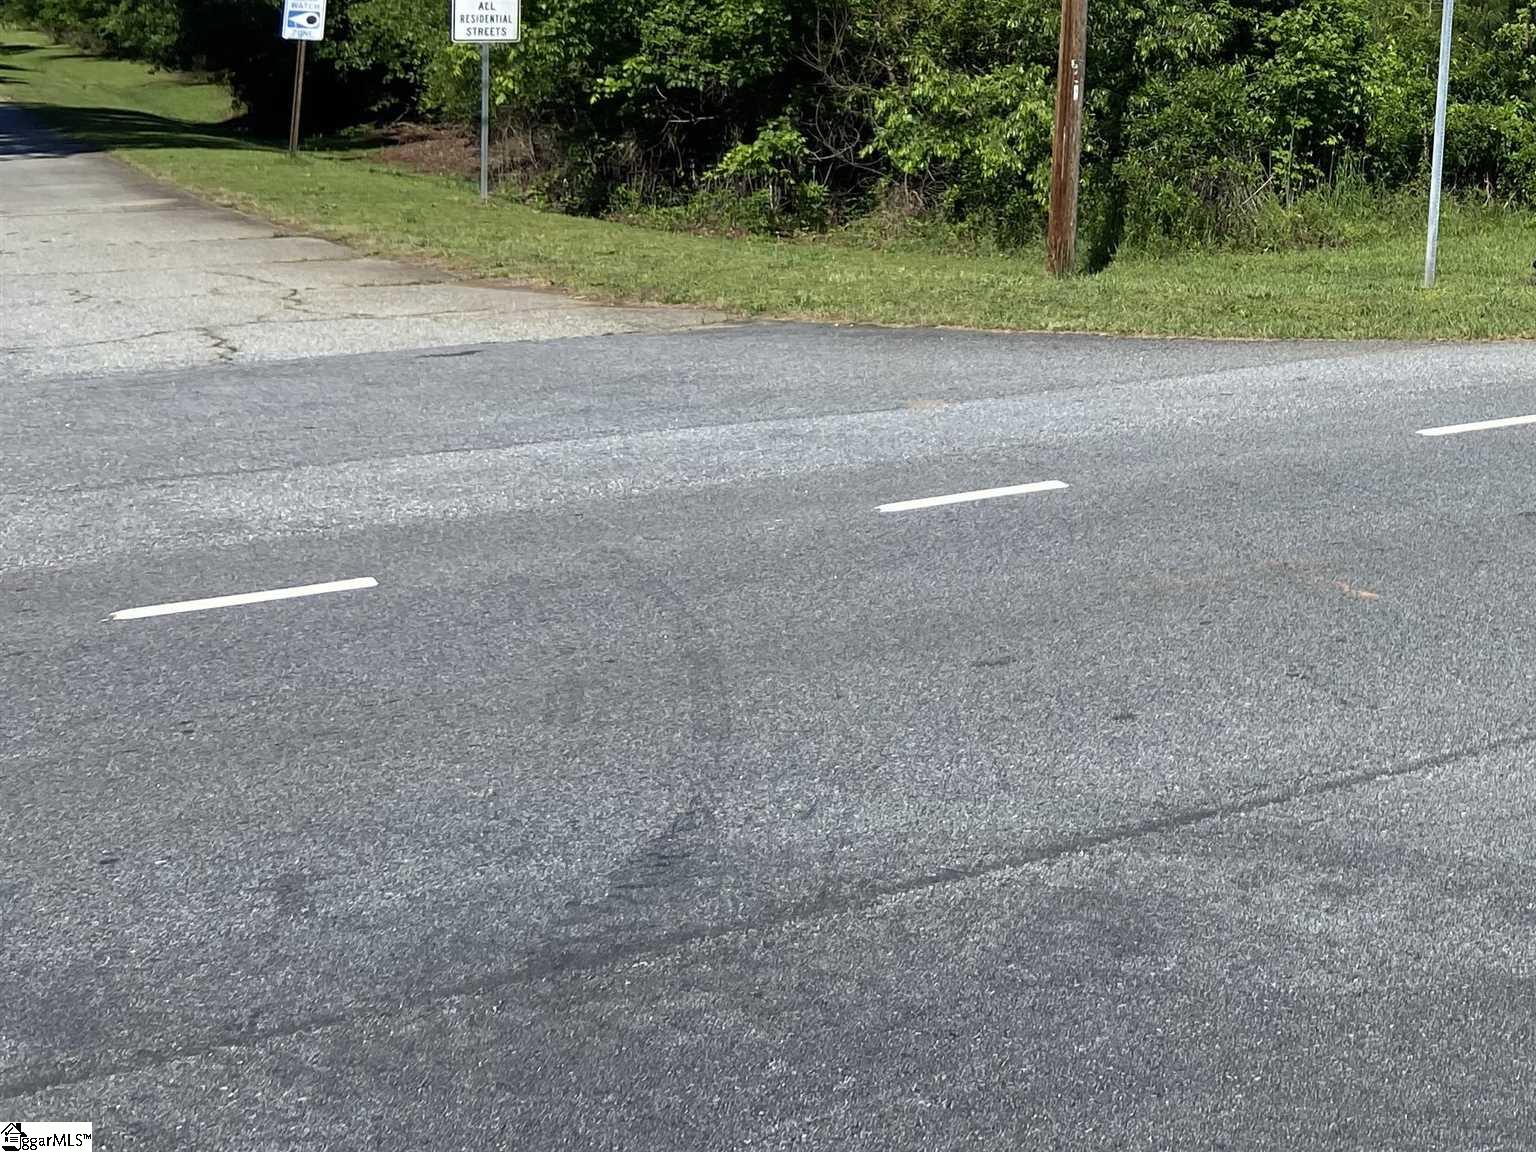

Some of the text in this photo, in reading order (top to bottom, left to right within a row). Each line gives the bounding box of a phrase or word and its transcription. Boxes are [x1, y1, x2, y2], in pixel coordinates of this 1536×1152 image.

[478, 1, 496, 11] ALL
[460, 14, 513, 24] RESIDENTIAL
[465, 27, 508, 37] STREETS
